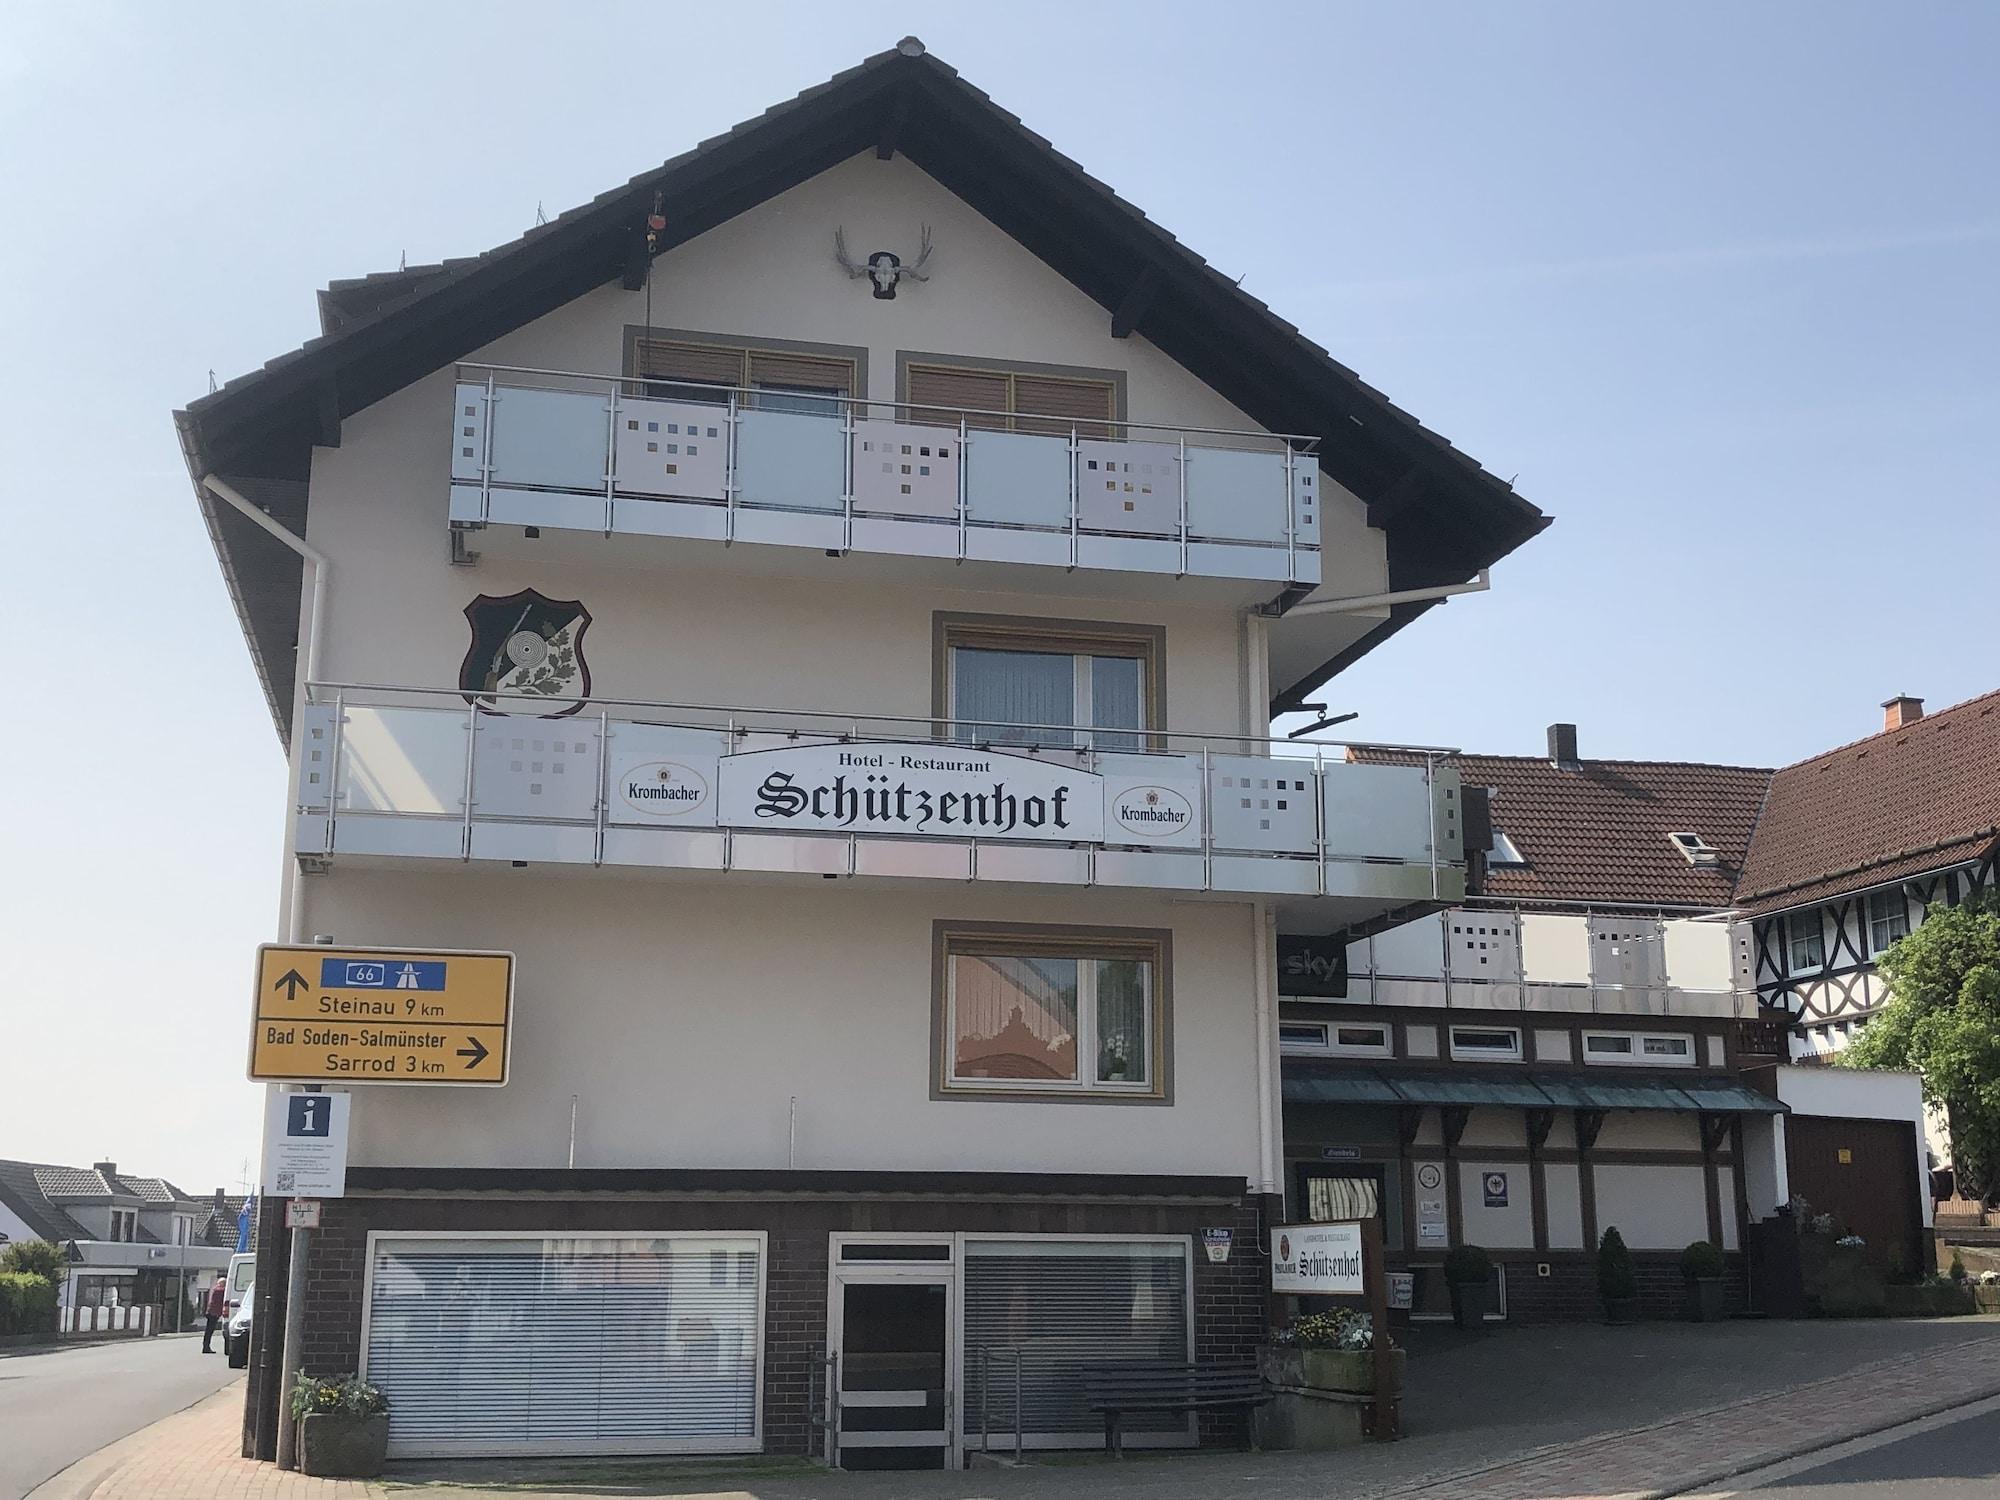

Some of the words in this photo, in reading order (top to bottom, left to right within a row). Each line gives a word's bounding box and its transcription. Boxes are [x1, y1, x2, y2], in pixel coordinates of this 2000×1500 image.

[839, 753, 883, 767] Hotel
[900, 756, 991, 773] Restaurant
[629, 783, 700, 800] Krombacher
[754, 771, 1070, 834] Schützenhof
[1121, 805, 1185, 823] Krombacher
[356, 967, 374, 981] 66
[1286, 949, 1338, 981] sky
[319, 996, 394, 1015] Steinau
[405, 999, 416, 1015] 9
[421, 1002, 444, 1016] km
[267, 1027, 294, 1045] Bad
[303, 1029, 447, 1048] Soden-Salmünster
[326, 1054, 395, 1072] Sarrod
[405, 1056, 417, 1072] 3
[421, 1059, 445, 1073] km
[1299, 1250, 1359, 1282] Schützenhof
